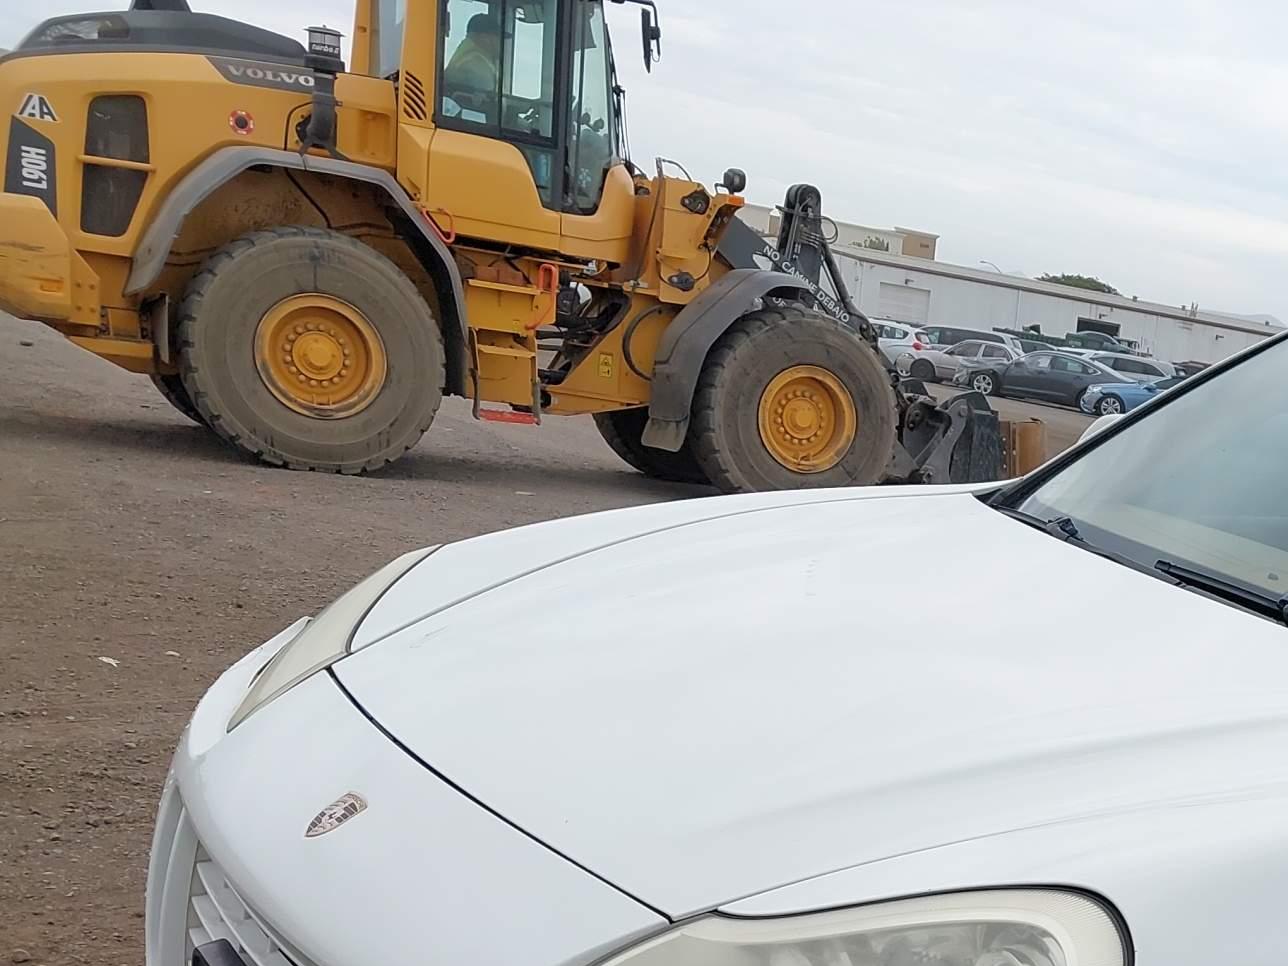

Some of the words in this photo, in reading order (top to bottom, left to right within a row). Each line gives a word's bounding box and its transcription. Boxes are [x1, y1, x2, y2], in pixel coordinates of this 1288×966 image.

[226, 64, 315, 87] VOLVO
[20, 145, 48, 190] L90H
[763, 245, 780, 261] NO
[781, 261, 818, 294] CAMINE
[816, 290, 850, 322] DEBAJO
